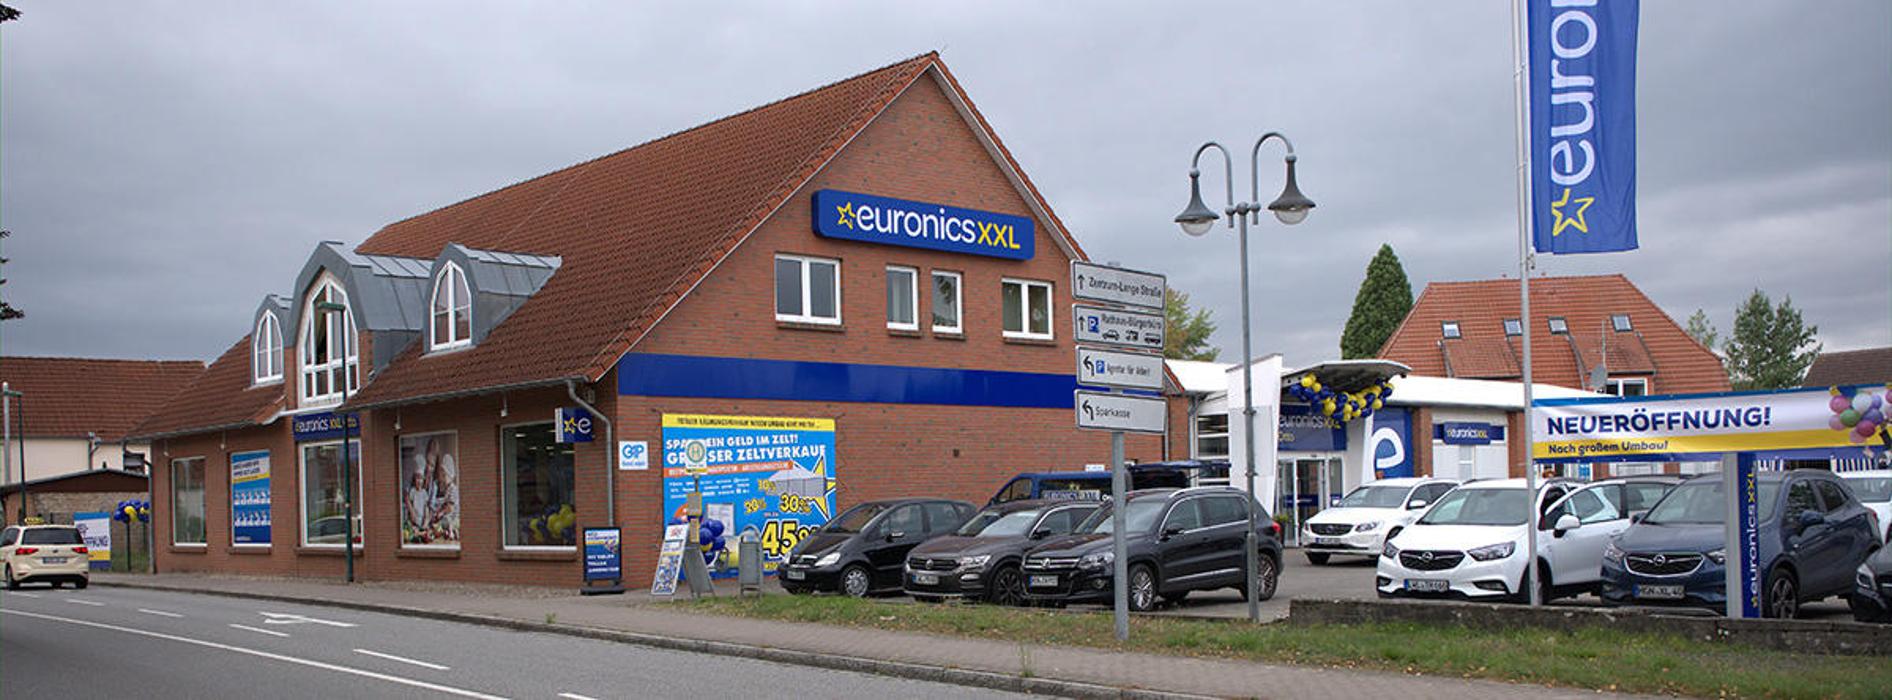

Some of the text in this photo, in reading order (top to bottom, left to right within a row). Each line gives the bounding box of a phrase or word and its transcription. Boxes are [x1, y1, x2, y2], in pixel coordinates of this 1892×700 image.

[1551, 0, 1598, 186] euro
[1141, 285, 1162, 298] Straße
[1095, 406, 1131, 419] Sparkasse
[1547, 406, 1771, 436] NEUERÖFFNUNG!
[577, 417, 592, 434] e
[727, 435, 752, 446] GELD
[756, 434, 769, 445] IM
[772, 433, 798, 445] ZELT!
[1372, 427, 1405, 469] e
[1578, 442, 1619, 456] großem
[1621, 440, 1668, 451] Umbau!
[736, 444, 827, 461] ZELTVERKAUF
[779, 492, 812, 514] 30%
